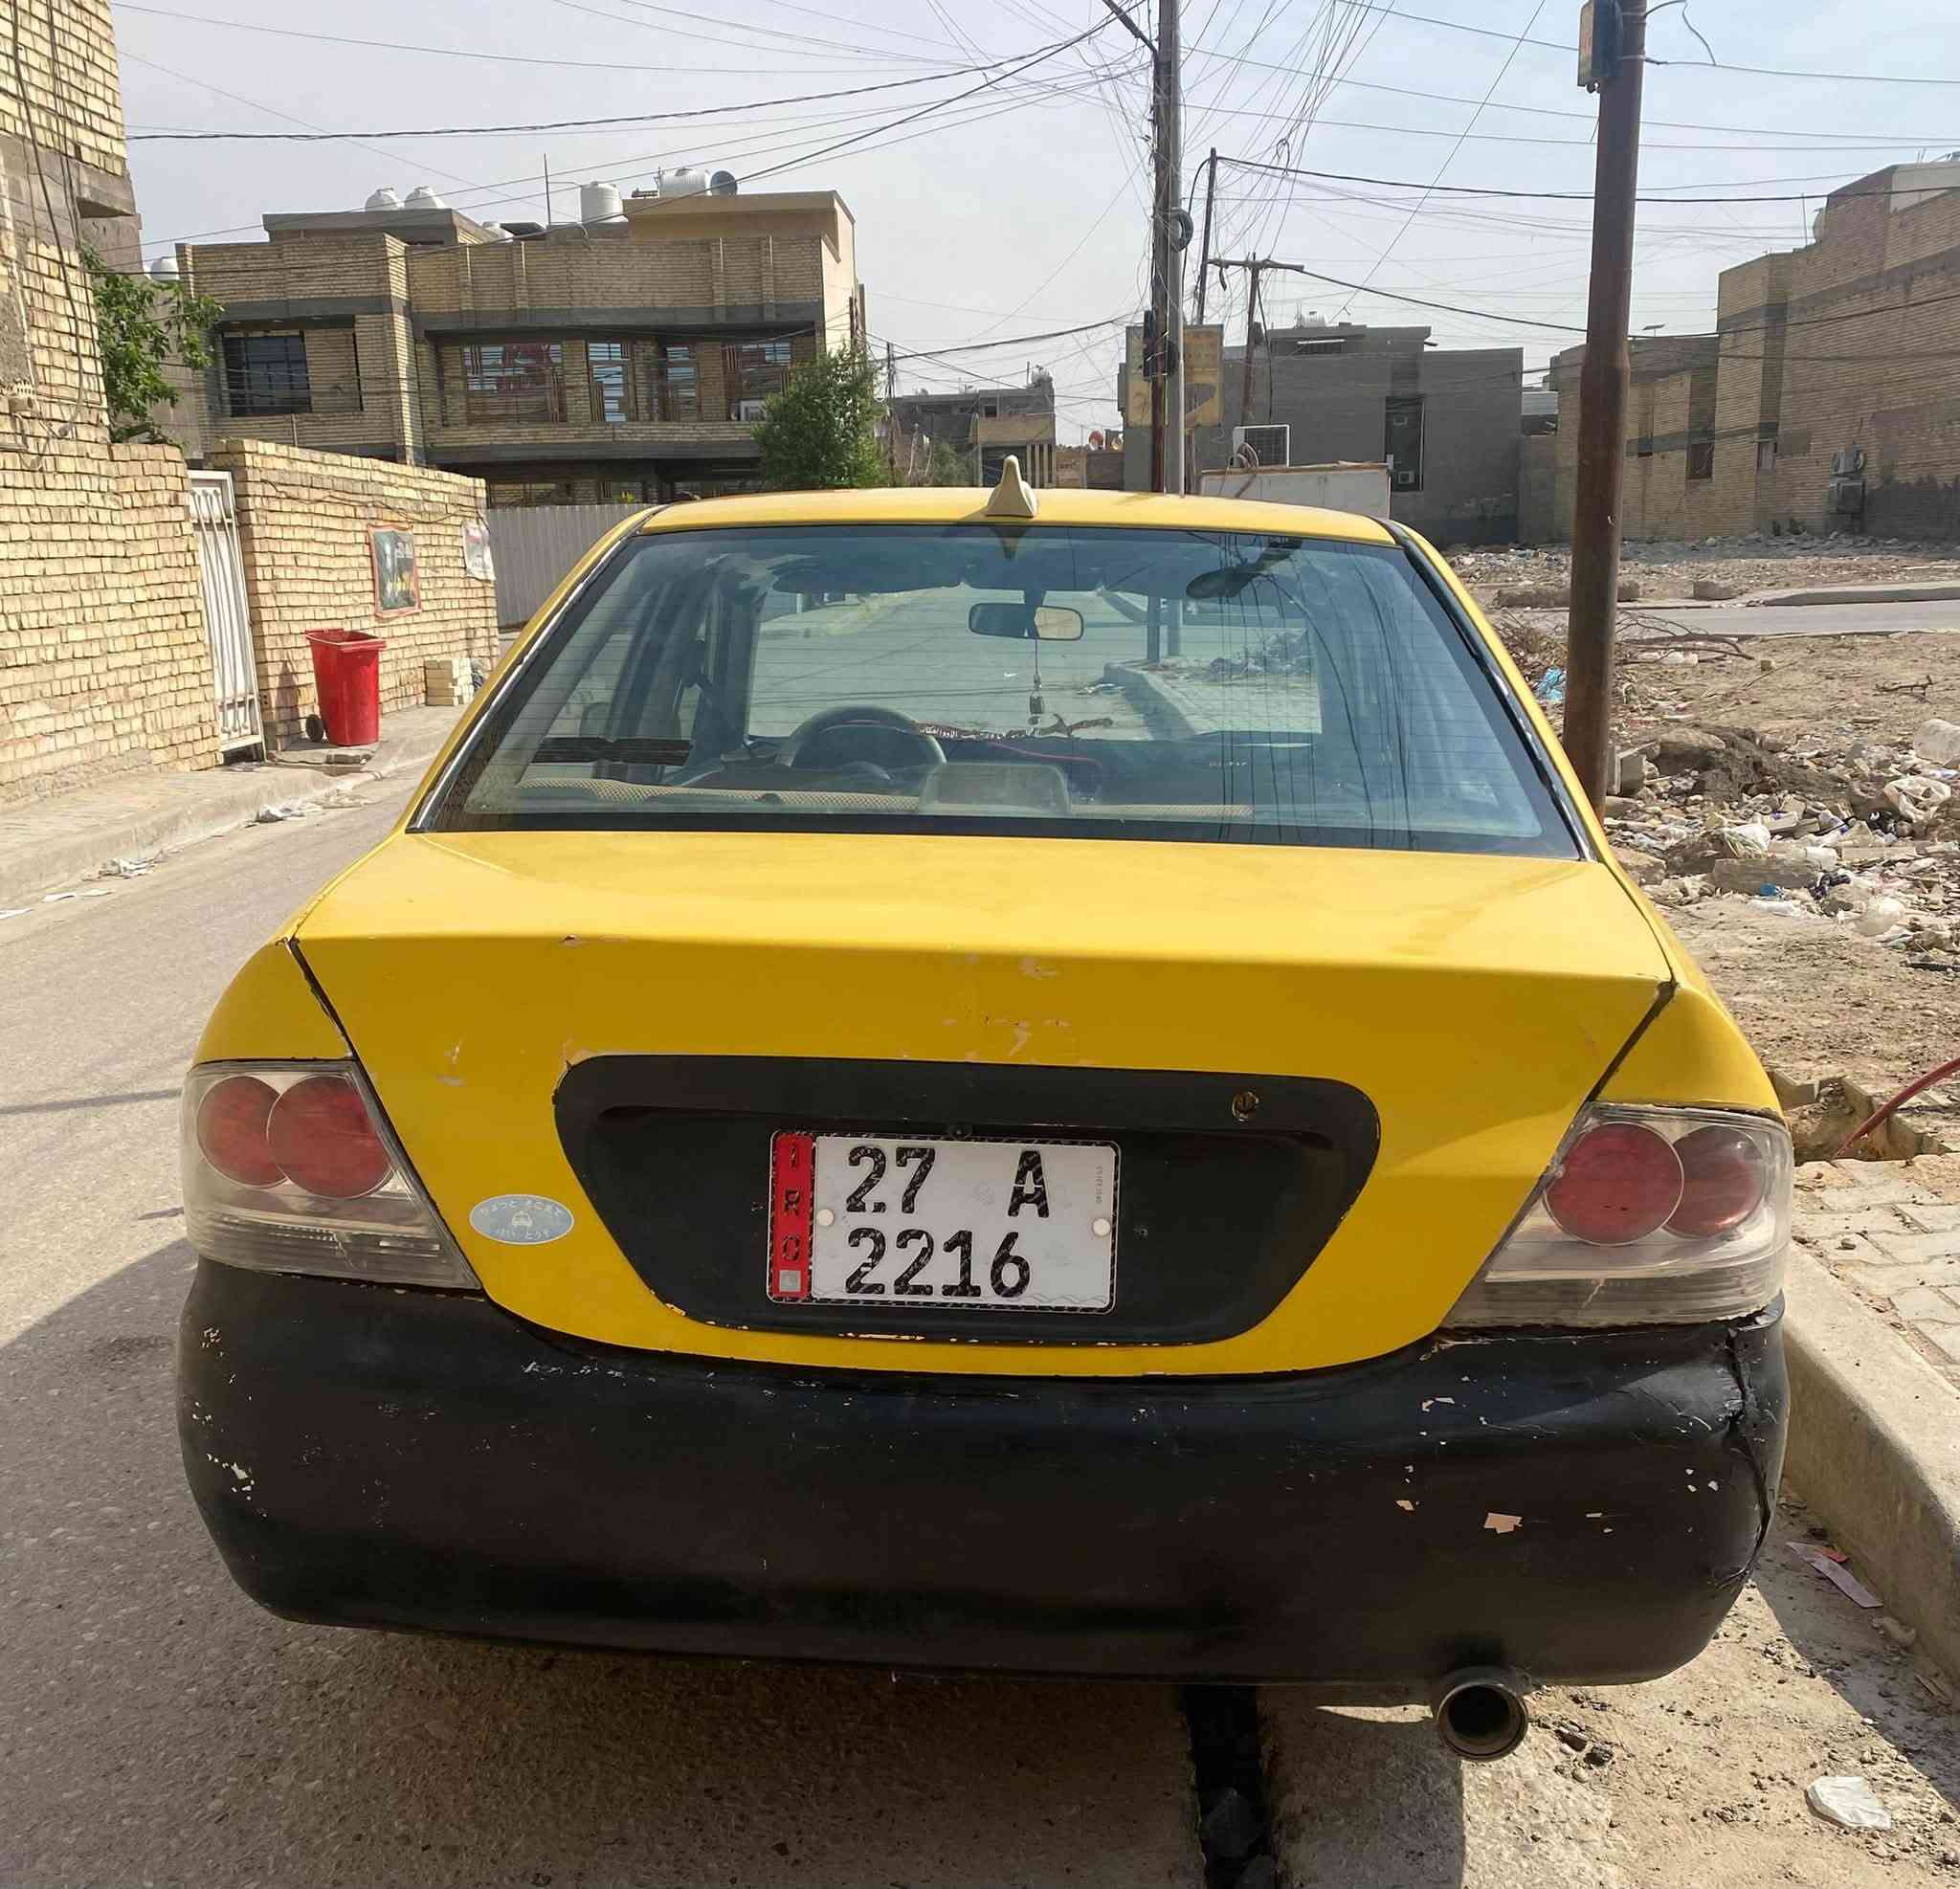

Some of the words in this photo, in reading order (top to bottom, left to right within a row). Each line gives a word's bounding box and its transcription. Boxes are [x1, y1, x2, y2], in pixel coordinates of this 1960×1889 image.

[846, 1145, 935, 1213] 27
[1008, 1150, 1049, 1218] A
[845, 1227, 1030, 1298] 2216
